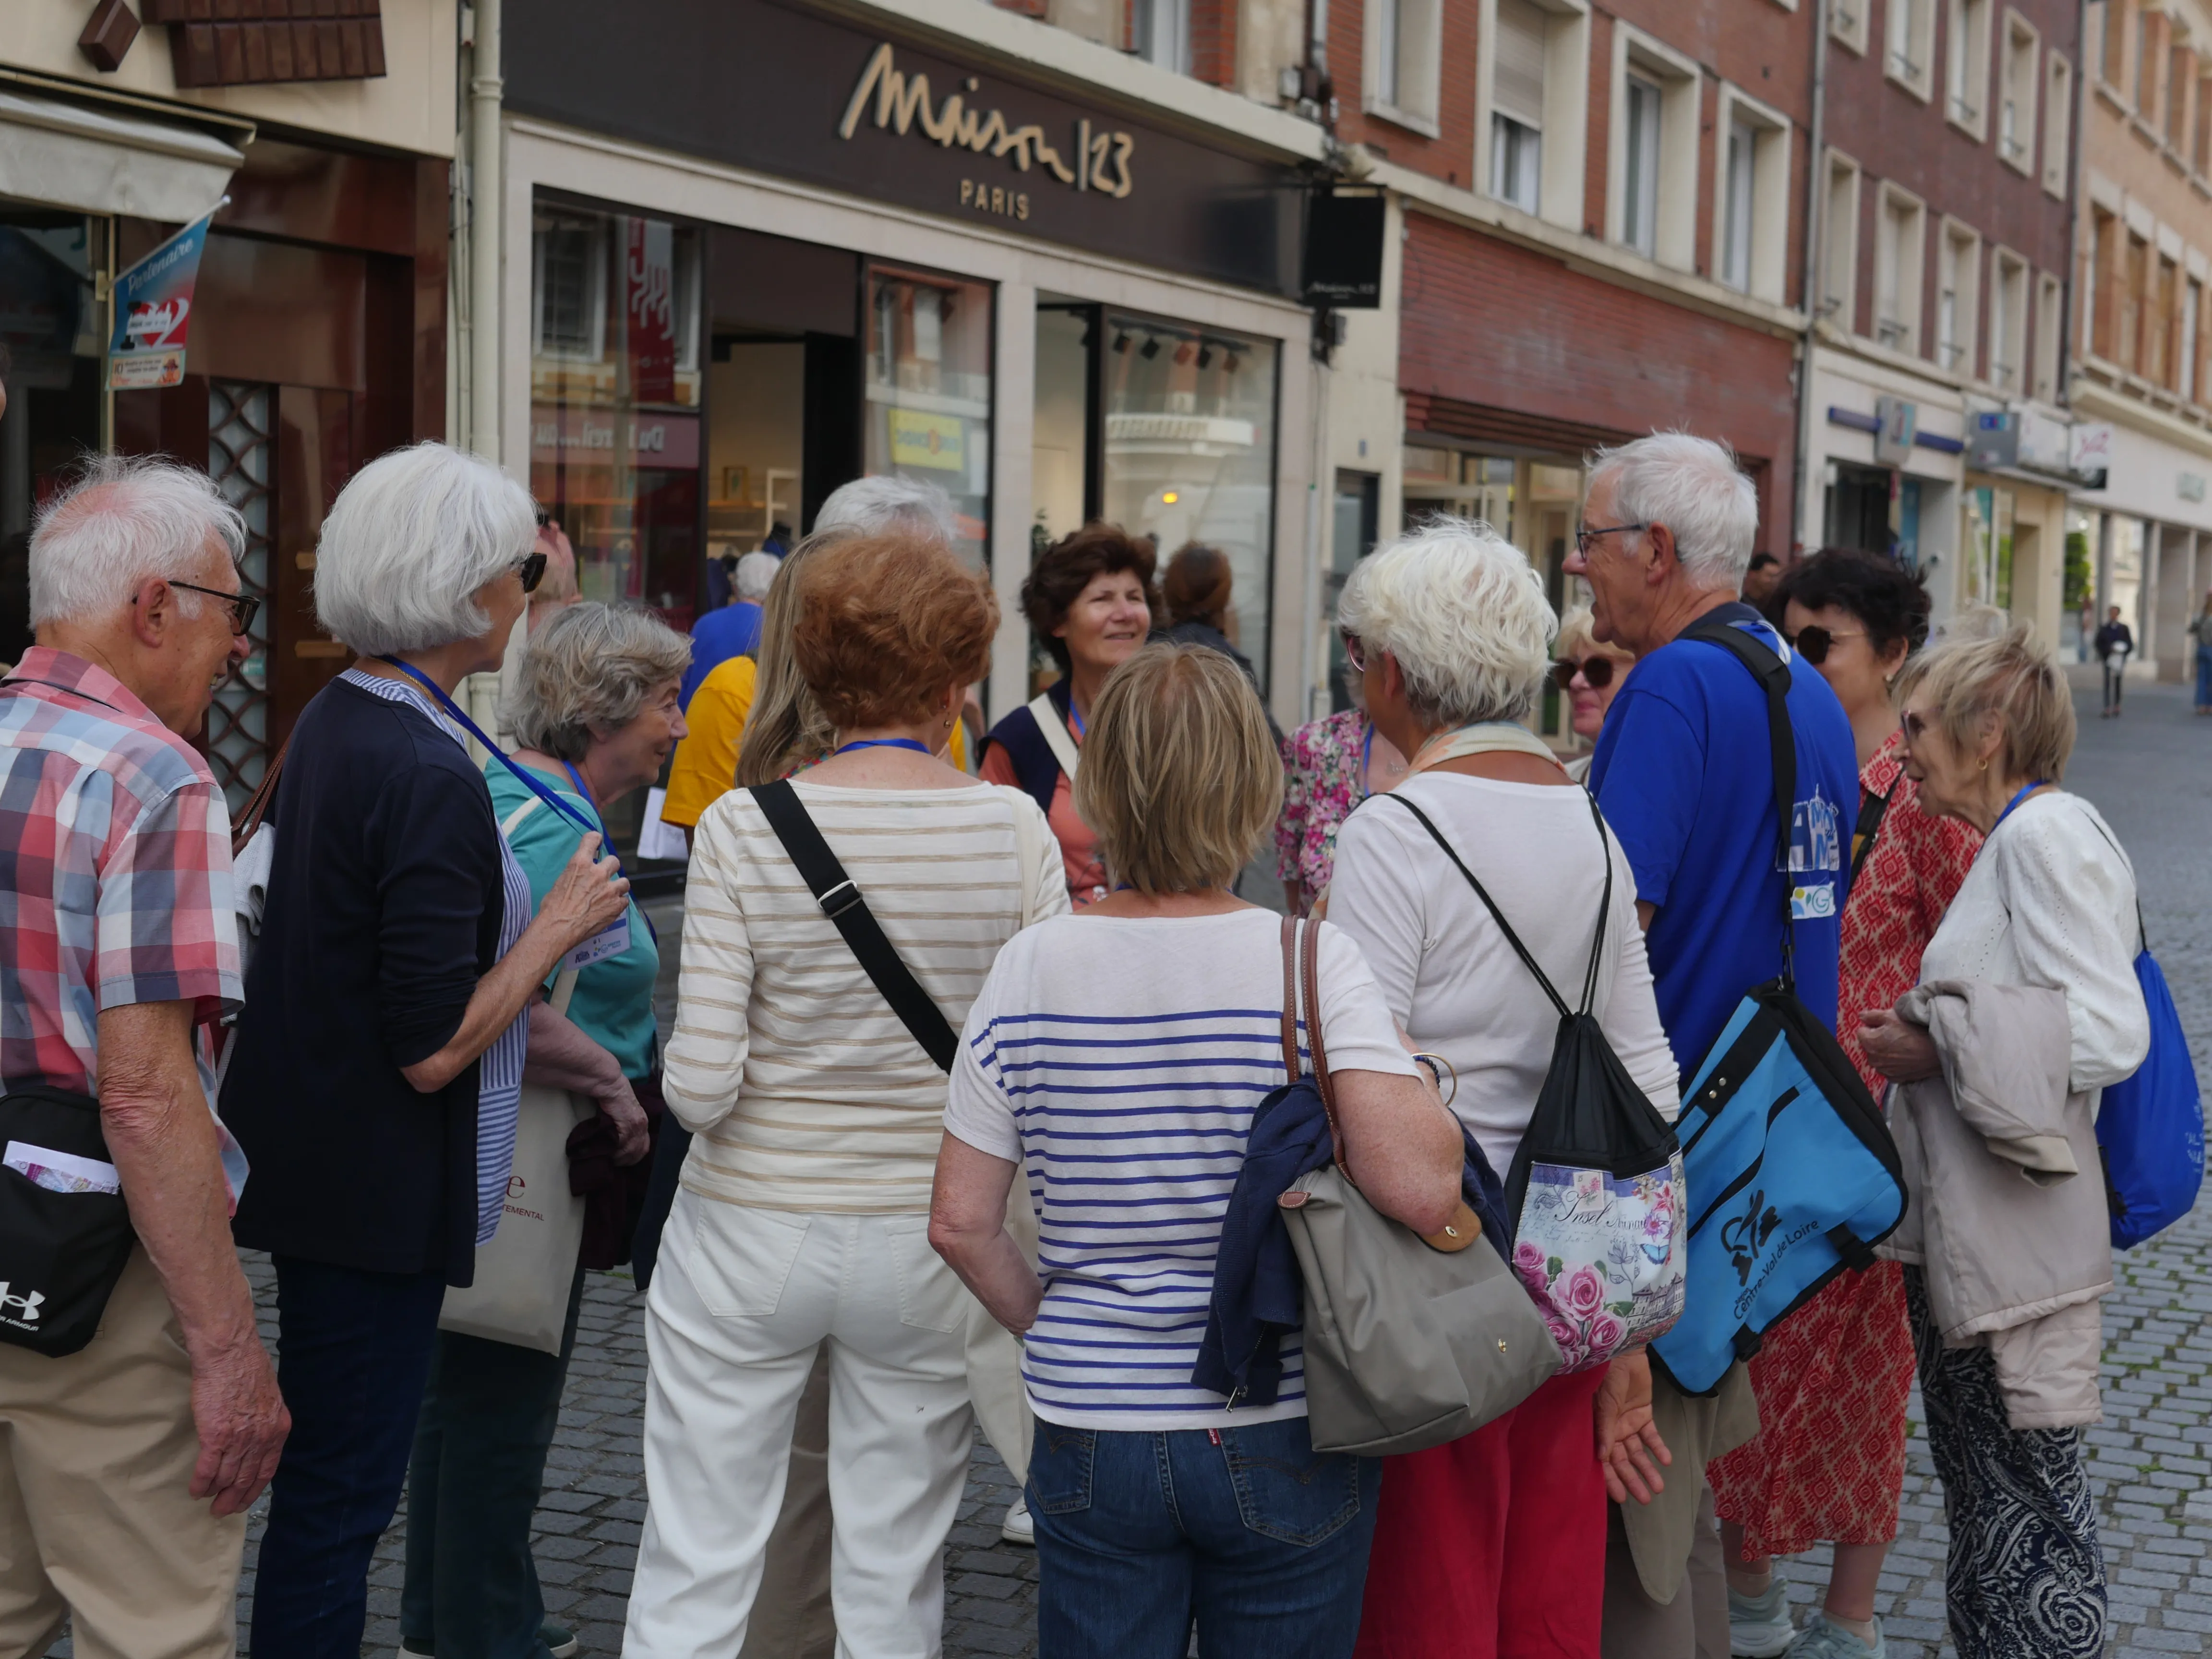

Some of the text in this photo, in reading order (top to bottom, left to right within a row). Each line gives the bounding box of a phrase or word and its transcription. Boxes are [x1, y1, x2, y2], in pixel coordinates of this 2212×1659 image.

[839, 43, 1133, 198] Maison 123
[961, 179, 1029, 220] PARIS
[128, 239, 193, 296] Partenaire
[1554, 1190, 1613, 1225] Insel
[1777, 1241, 1787, 1259] de
[1785, 1220, 1819, 1245] Loire
[6, 1318, 40, 1332] ARMOUR
